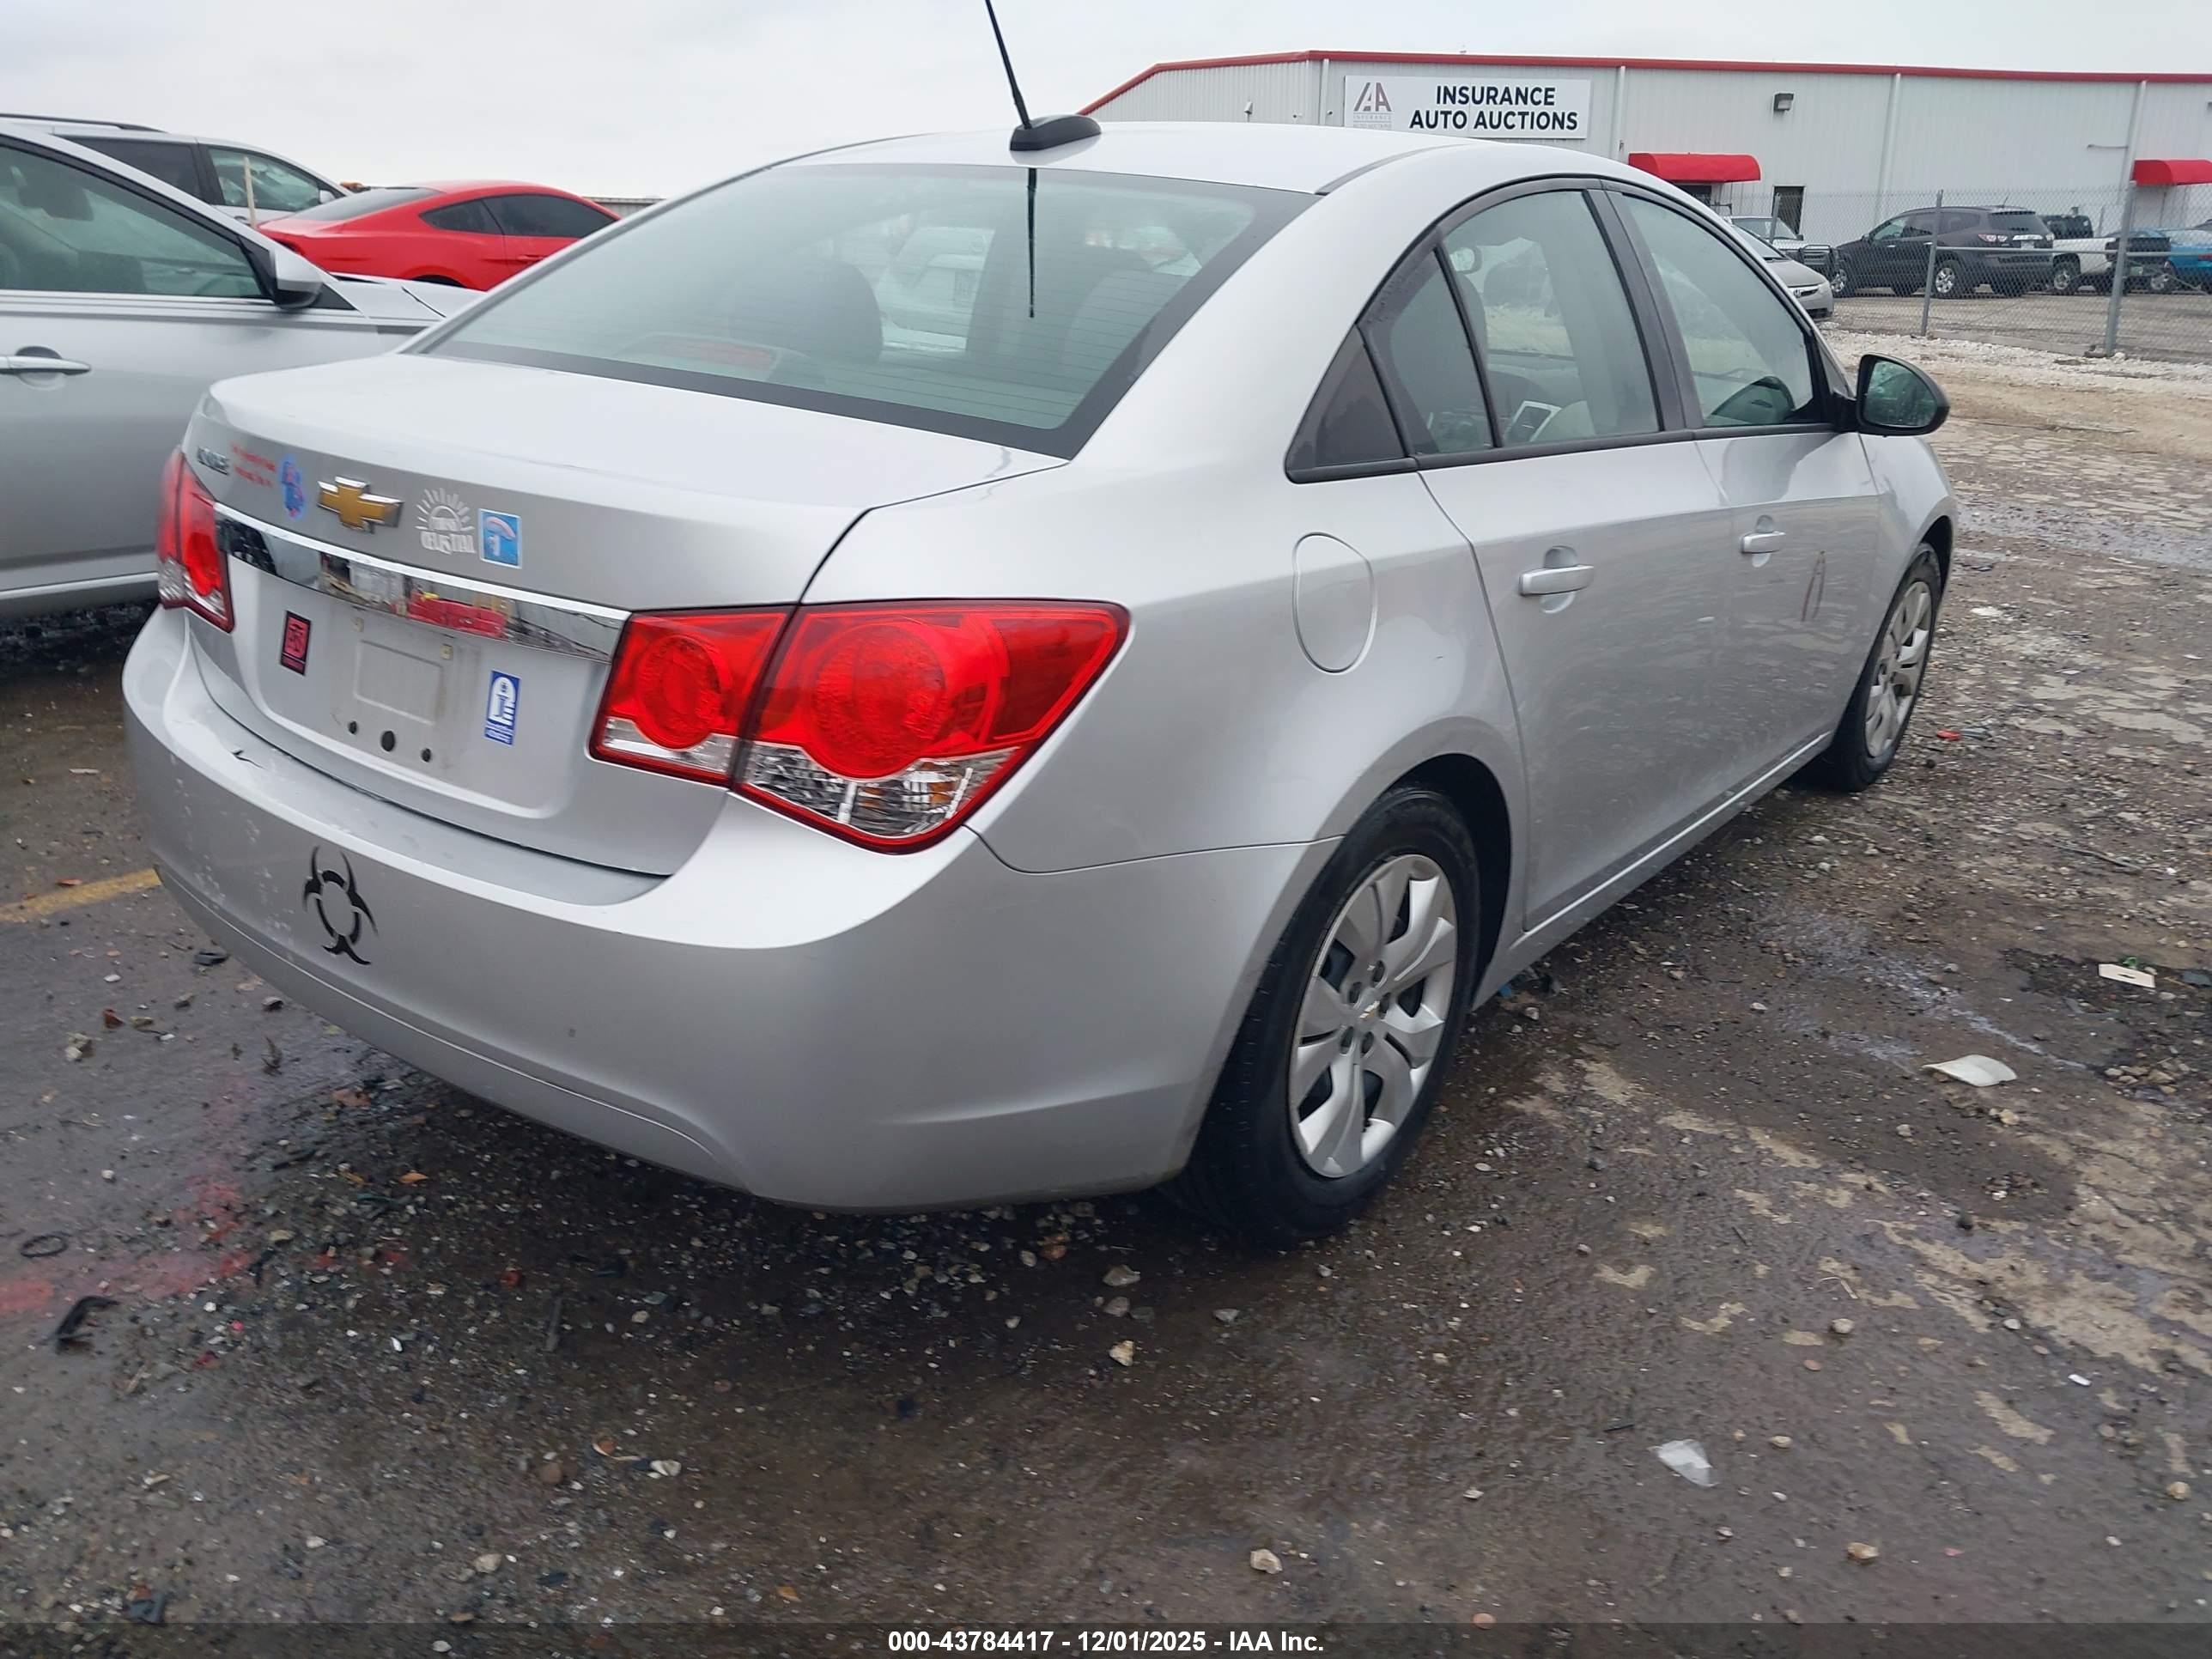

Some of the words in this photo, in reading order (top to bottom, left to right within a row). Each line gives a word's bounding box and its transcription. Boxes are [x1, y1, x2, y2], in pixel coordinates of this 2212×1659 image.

[1436, 85, 1556, 106] INSURANCE
[1409, 109, 1468, 130] AUTO
[1474, 110, 1577, 131] AUCTIONS
